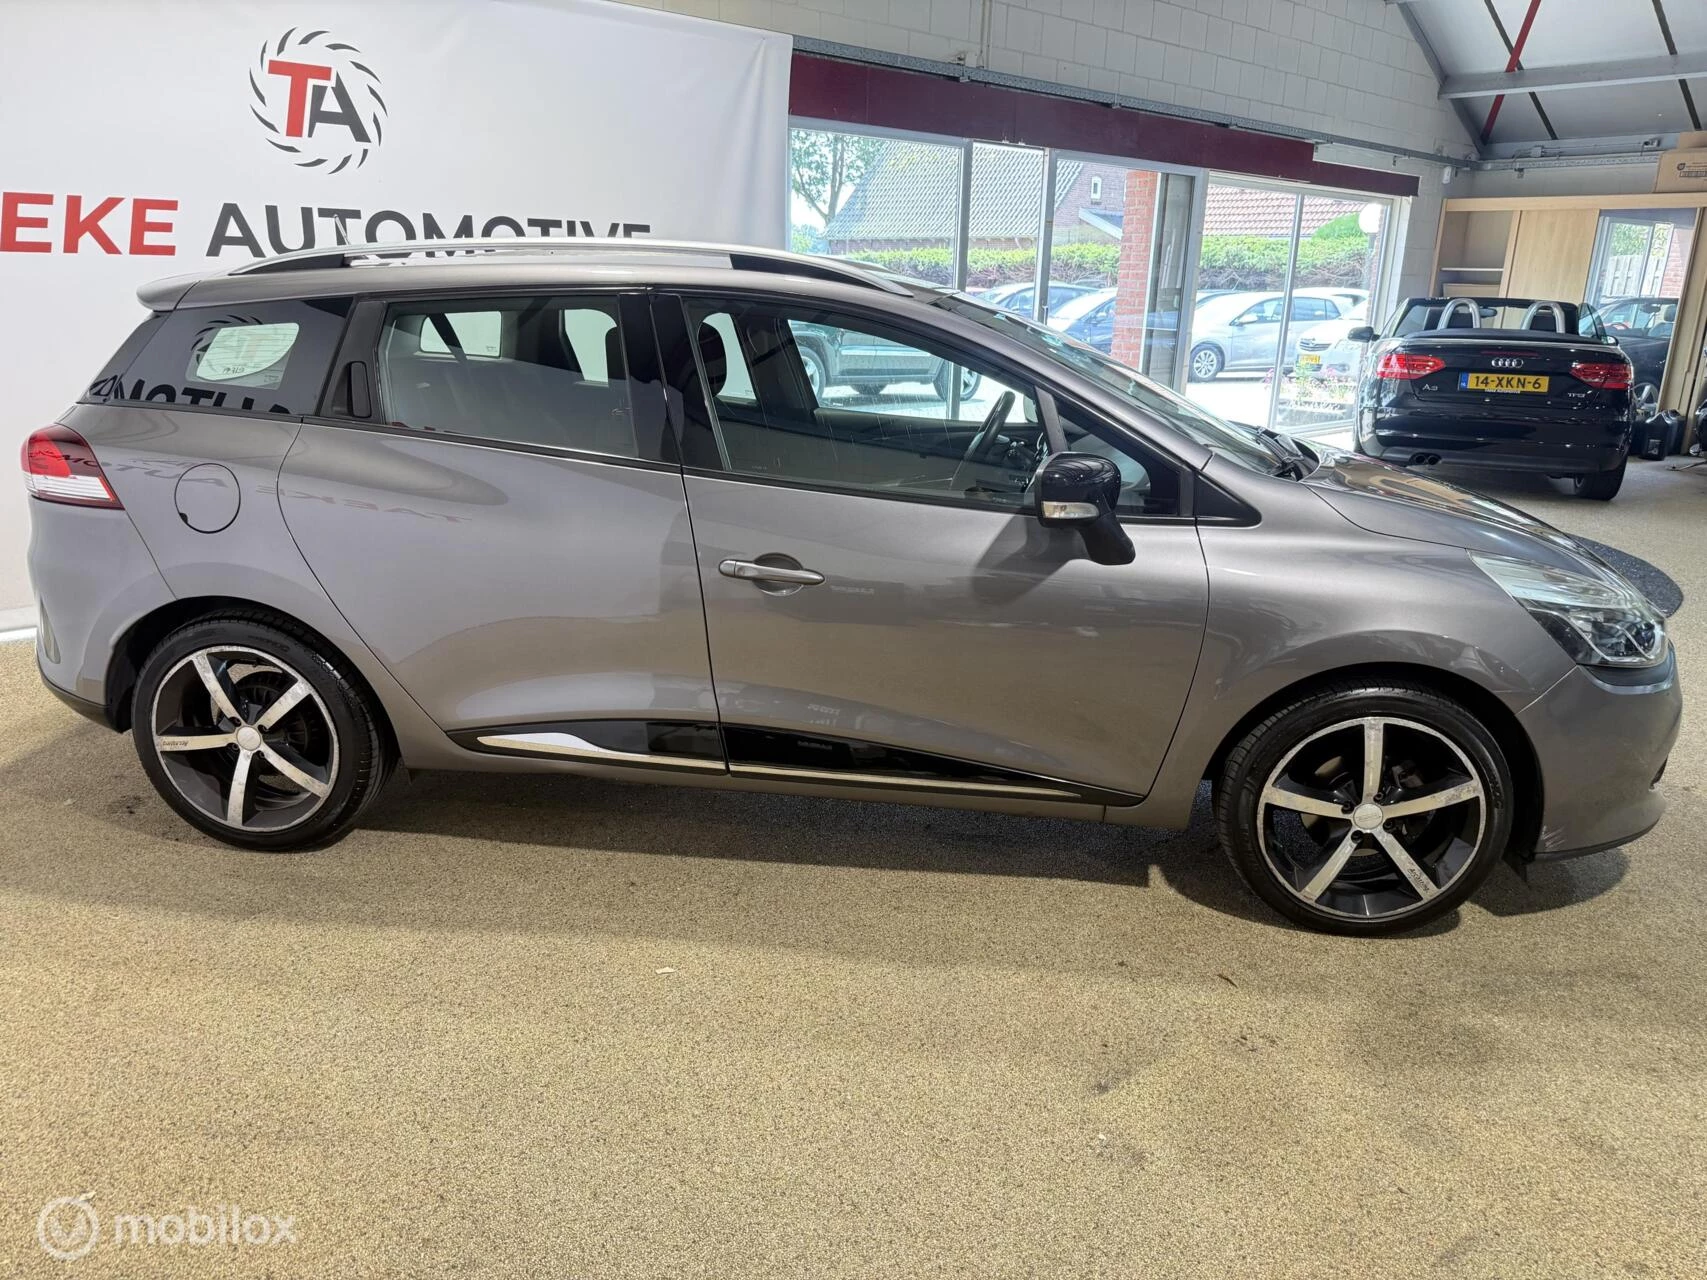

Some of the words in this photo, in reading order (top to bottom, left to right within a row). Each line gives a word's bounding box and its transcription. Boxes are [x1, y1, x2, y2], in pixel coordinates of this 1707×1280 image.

[0, 192, 179, 256] EKE
[1422, 383, 1438, 391] A3
[1475, 375, 1542, 389] 14-XKN-6
